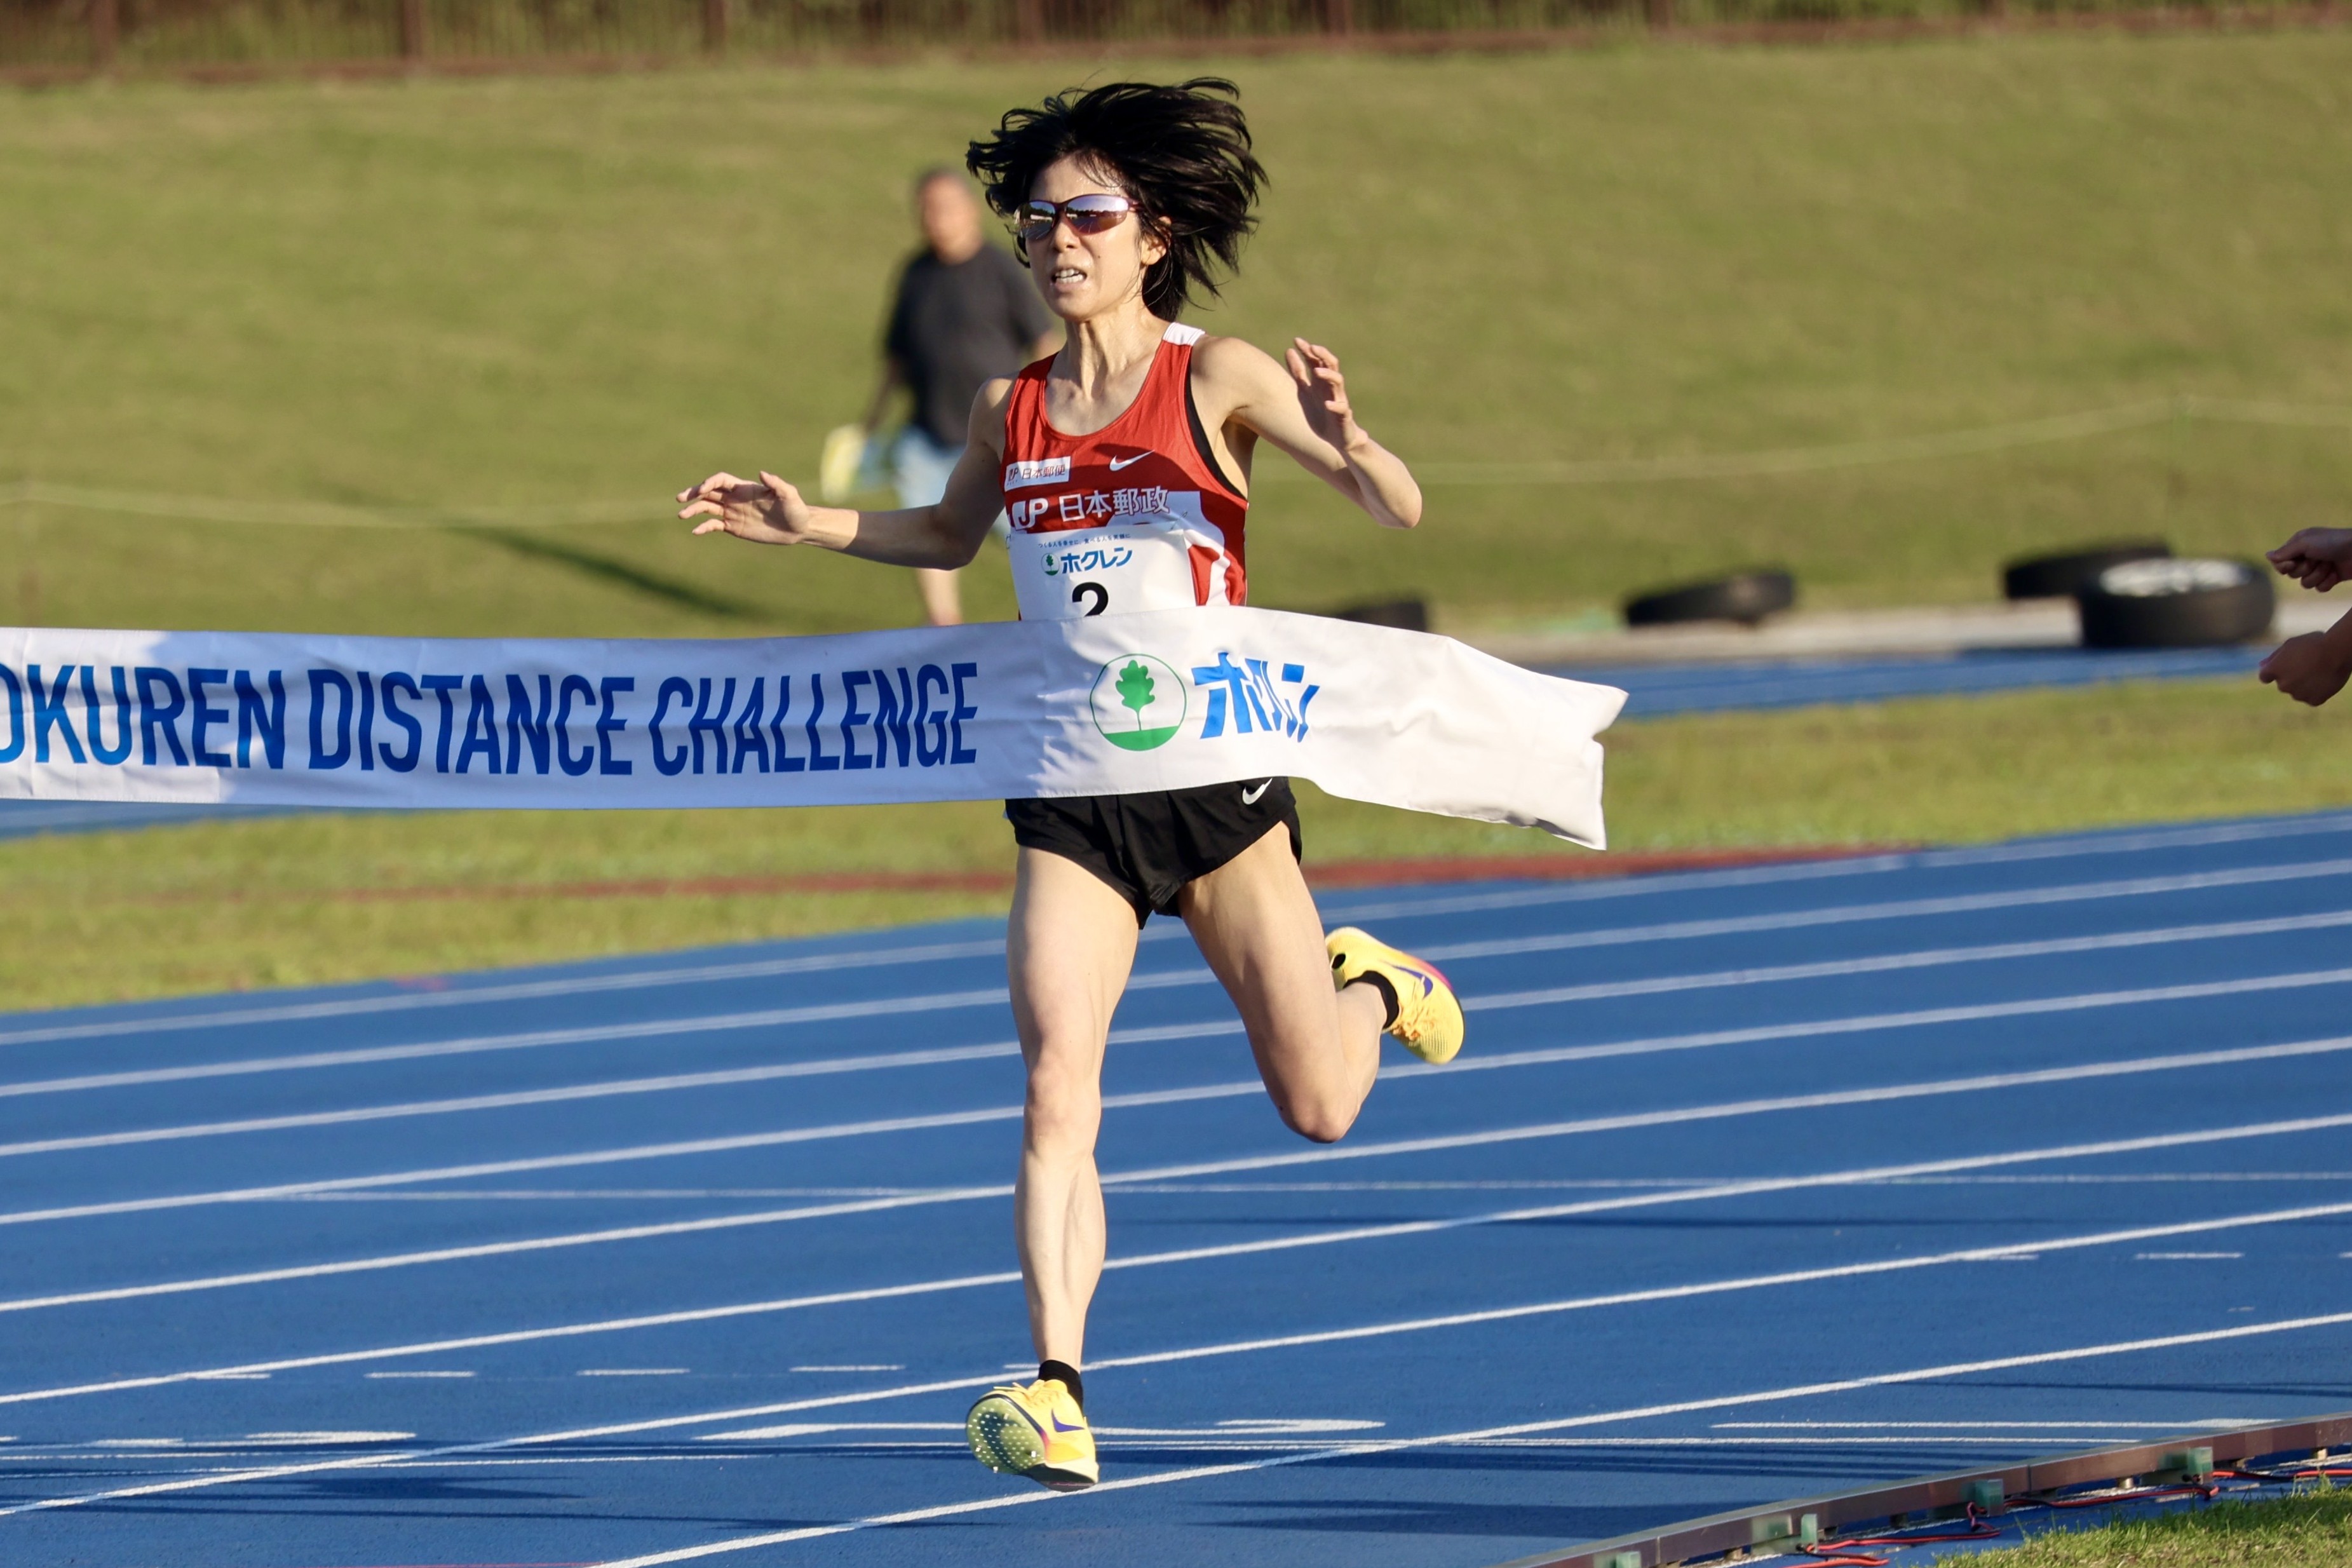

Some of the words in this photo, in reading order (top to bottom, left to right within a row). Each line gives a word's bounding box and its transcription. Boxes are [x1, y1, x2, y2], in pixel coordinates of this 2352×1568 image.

[1022, 464, 1065, 480] 日本郵便
[1011, 497, 1049, 531] JP
[1059, 485, 1170, 522] 日本郵政
[1060, 546, 1133, 574] ホクレン
[1072, 581, 1109, 617] 2
[308, 668, 635, 776] DISTANCE
[648, 662, 978, 776] CHALLENGE
